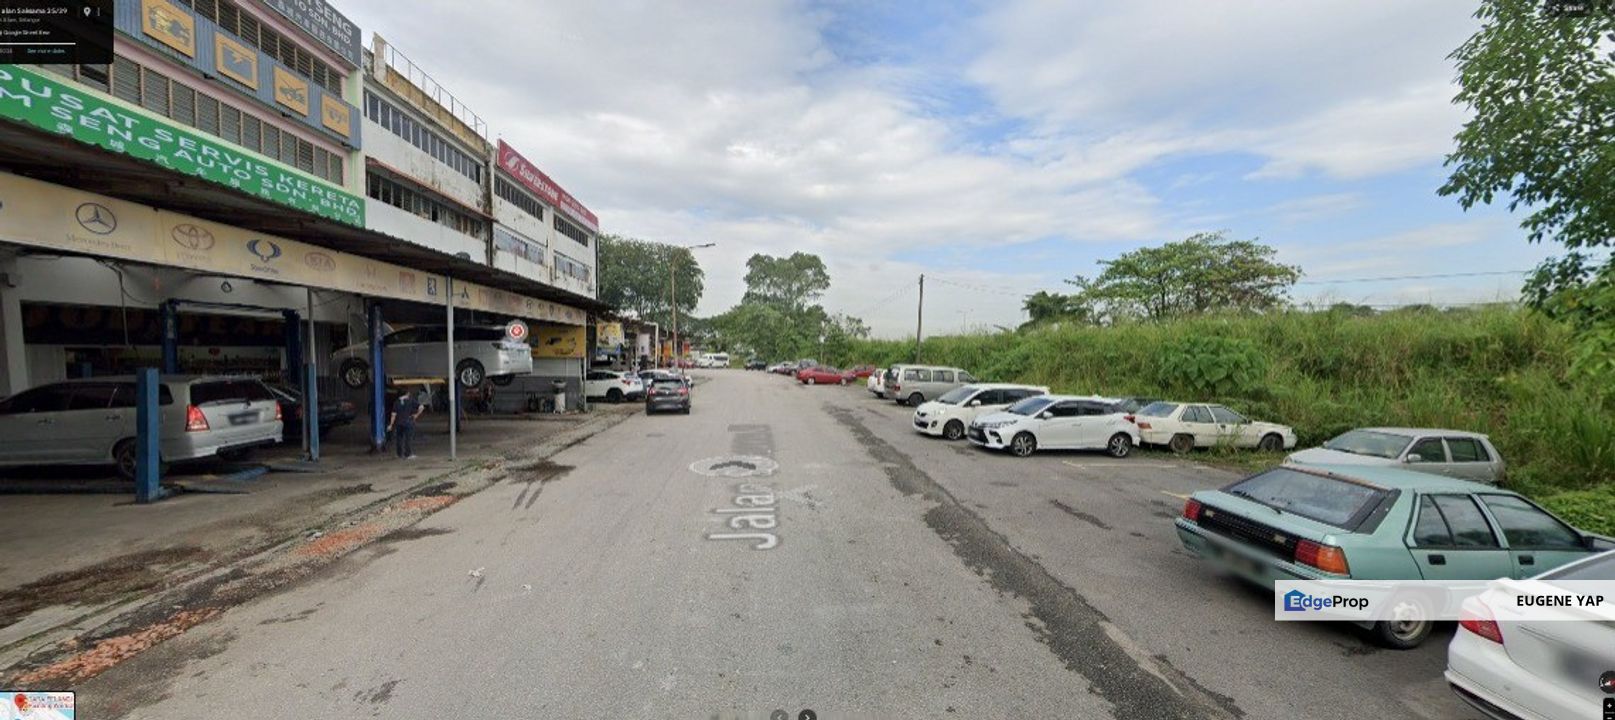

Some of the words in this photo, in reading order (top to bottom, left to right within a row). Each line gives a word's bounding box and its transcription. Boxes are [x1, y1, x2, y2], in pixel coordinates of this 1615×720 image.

[314, 0, 353, 37] SENG
[51, 106, 161, 151] SENG
[174, 149, 252, 180] AUTO
[154, 128, 269, 177] SERVIS
[280, 173, 361, 210] KERETA
